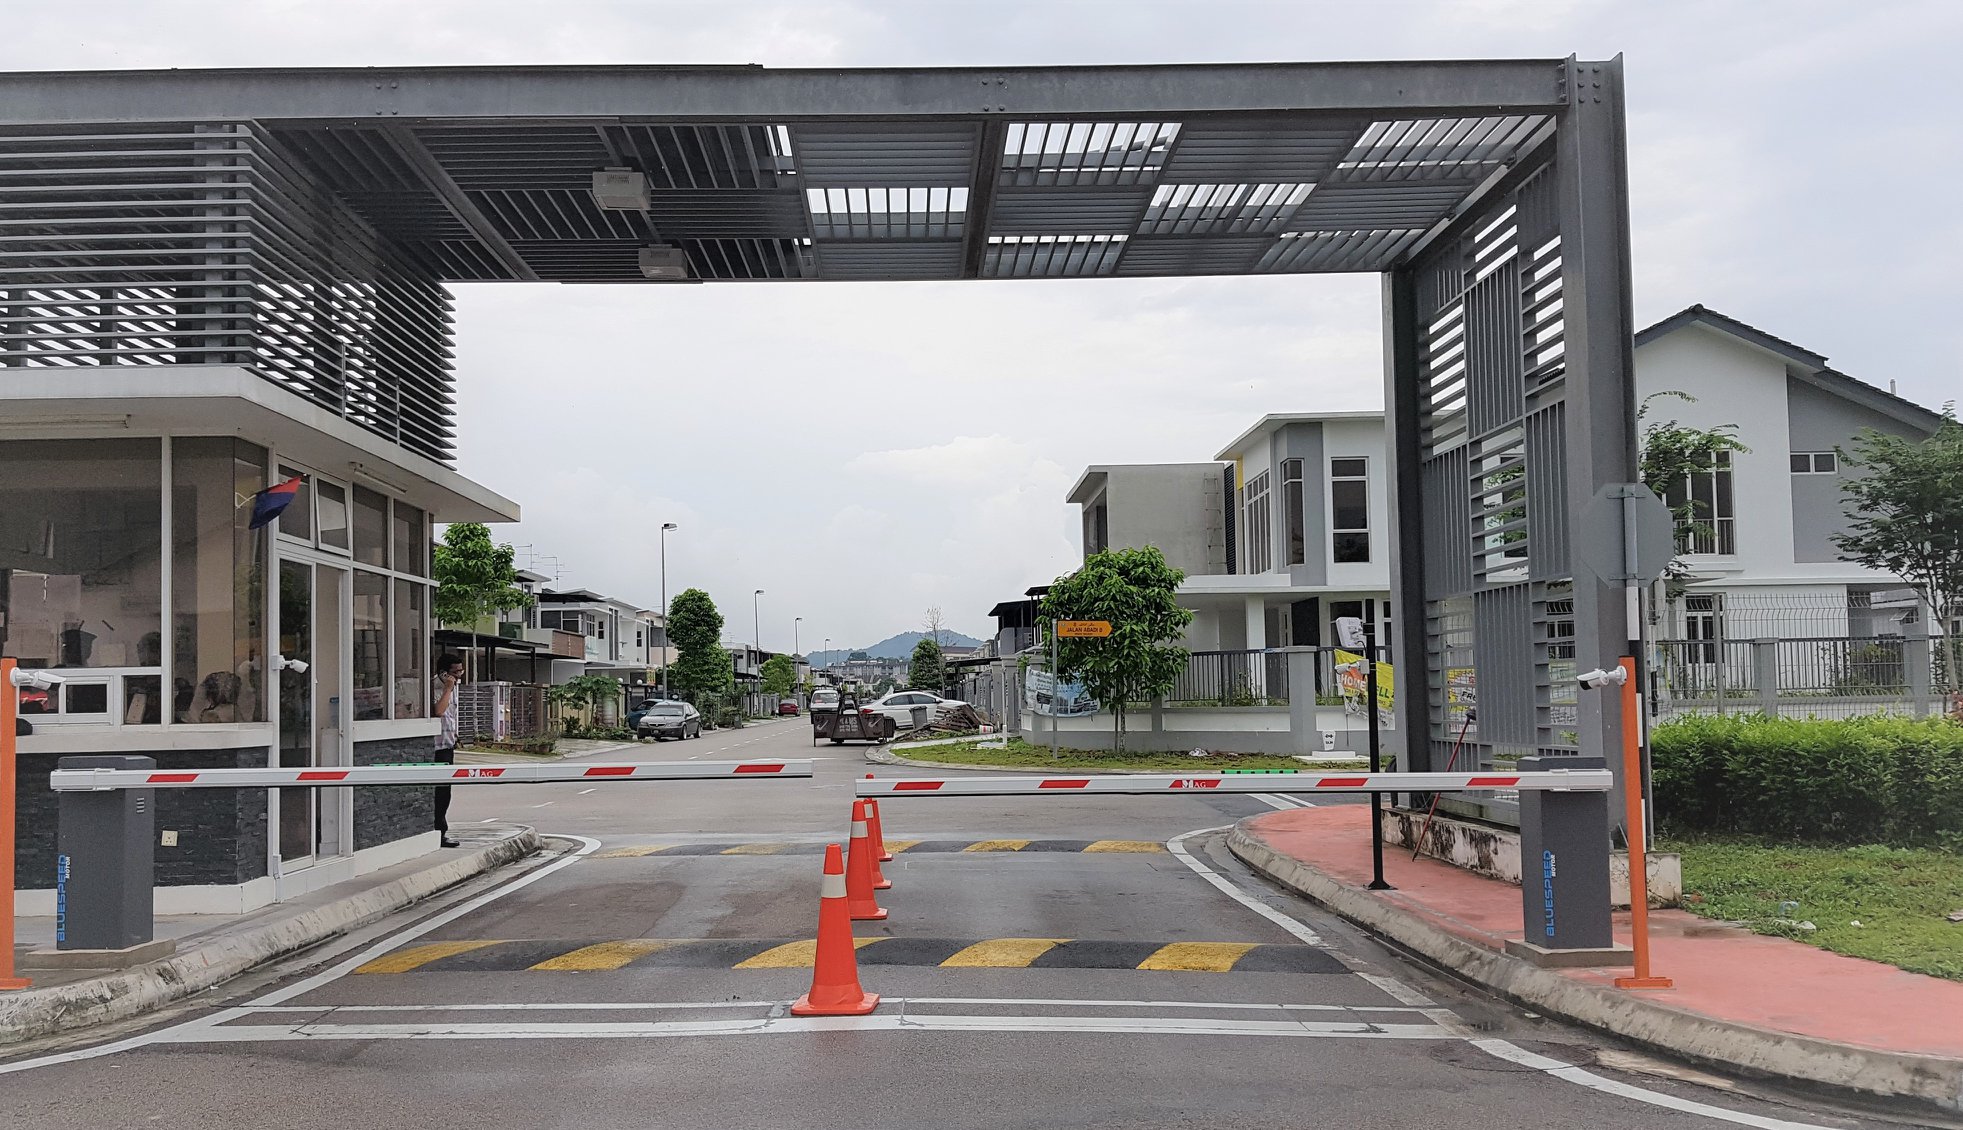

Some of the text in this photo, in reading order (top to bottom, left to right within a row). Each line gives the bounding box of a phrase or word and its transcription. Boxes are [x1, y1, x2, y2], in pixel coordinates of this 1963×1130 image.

[1341, 673, 1367, 691] HOME
[468, 769, 494, 778] MAG
[1181, 779, 1207, 788] MAG
[57, 854, 67, 942] BLUESPEED
[1543, 849, 1555, 937] BLUESPEED
